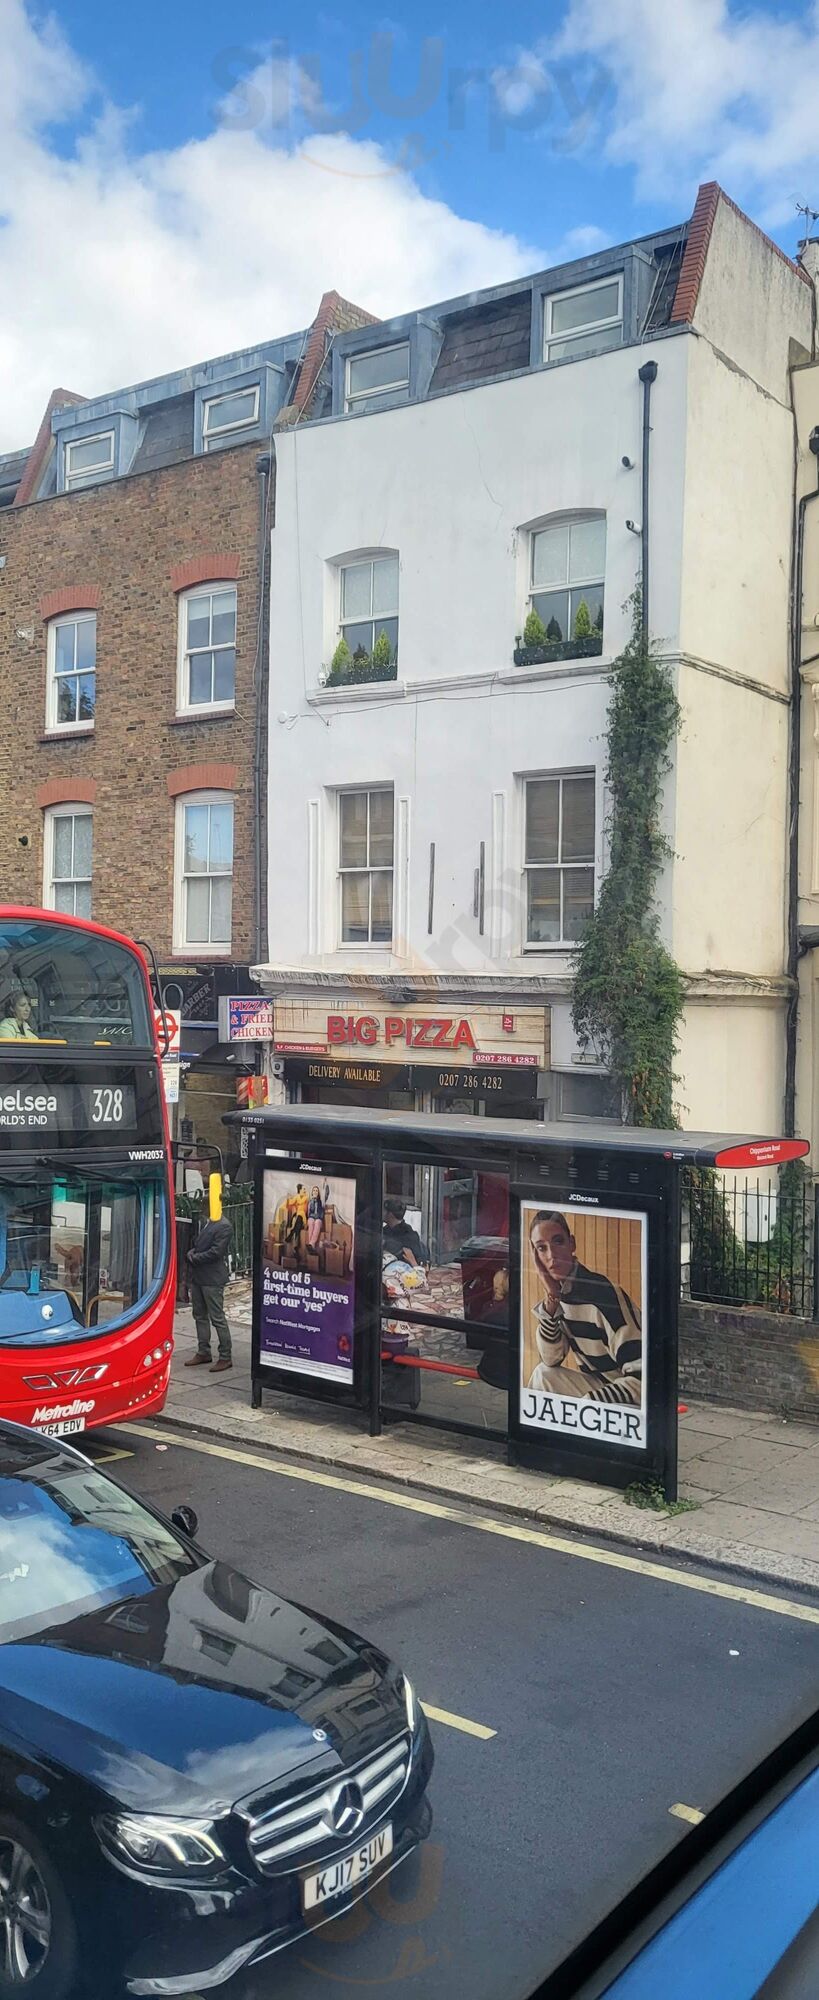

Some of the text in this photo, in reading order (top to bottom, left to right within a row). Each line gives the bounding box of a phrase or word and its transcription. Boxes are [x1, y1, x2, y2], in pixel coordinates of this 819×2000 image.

[231, 1001, 269, 1011] PIZZA
[231, 1014, 273, 1025] & FRIED
[231, 1027, 274, 1037] CHICKEN
[327, 1016, 478, 1048] BIG PIZZA
[308, 1065, 381, 1082] DELIVERY AVAILABLE
[439, 1074, 503, 1089] 0207 286 4282
[92, 1089, 123, 1122] 328
[28, 1115, 47, 1125] END
[128, 1150, 164, 1160] VWH2032
[299, 1163, 322, 1172] JCDecaux
[568, 1193, 599, 1204] JCDecaux
[263, 1267, 311, 1285] 4 out of 5
[263, 1280, 349, 1304] first-time buyers
[263, 1294, 279, 1306] get
[281, 1298, 300, 1308] our
[31, 1399, 95, 1424] Metroline
[523, 1394, 642, 1441] JAEGER
[63, 1419, 82, 1433] EDV
[316, 1856, 354, 1900] KJ17
[360, 1832, 385, 1873] SUV
